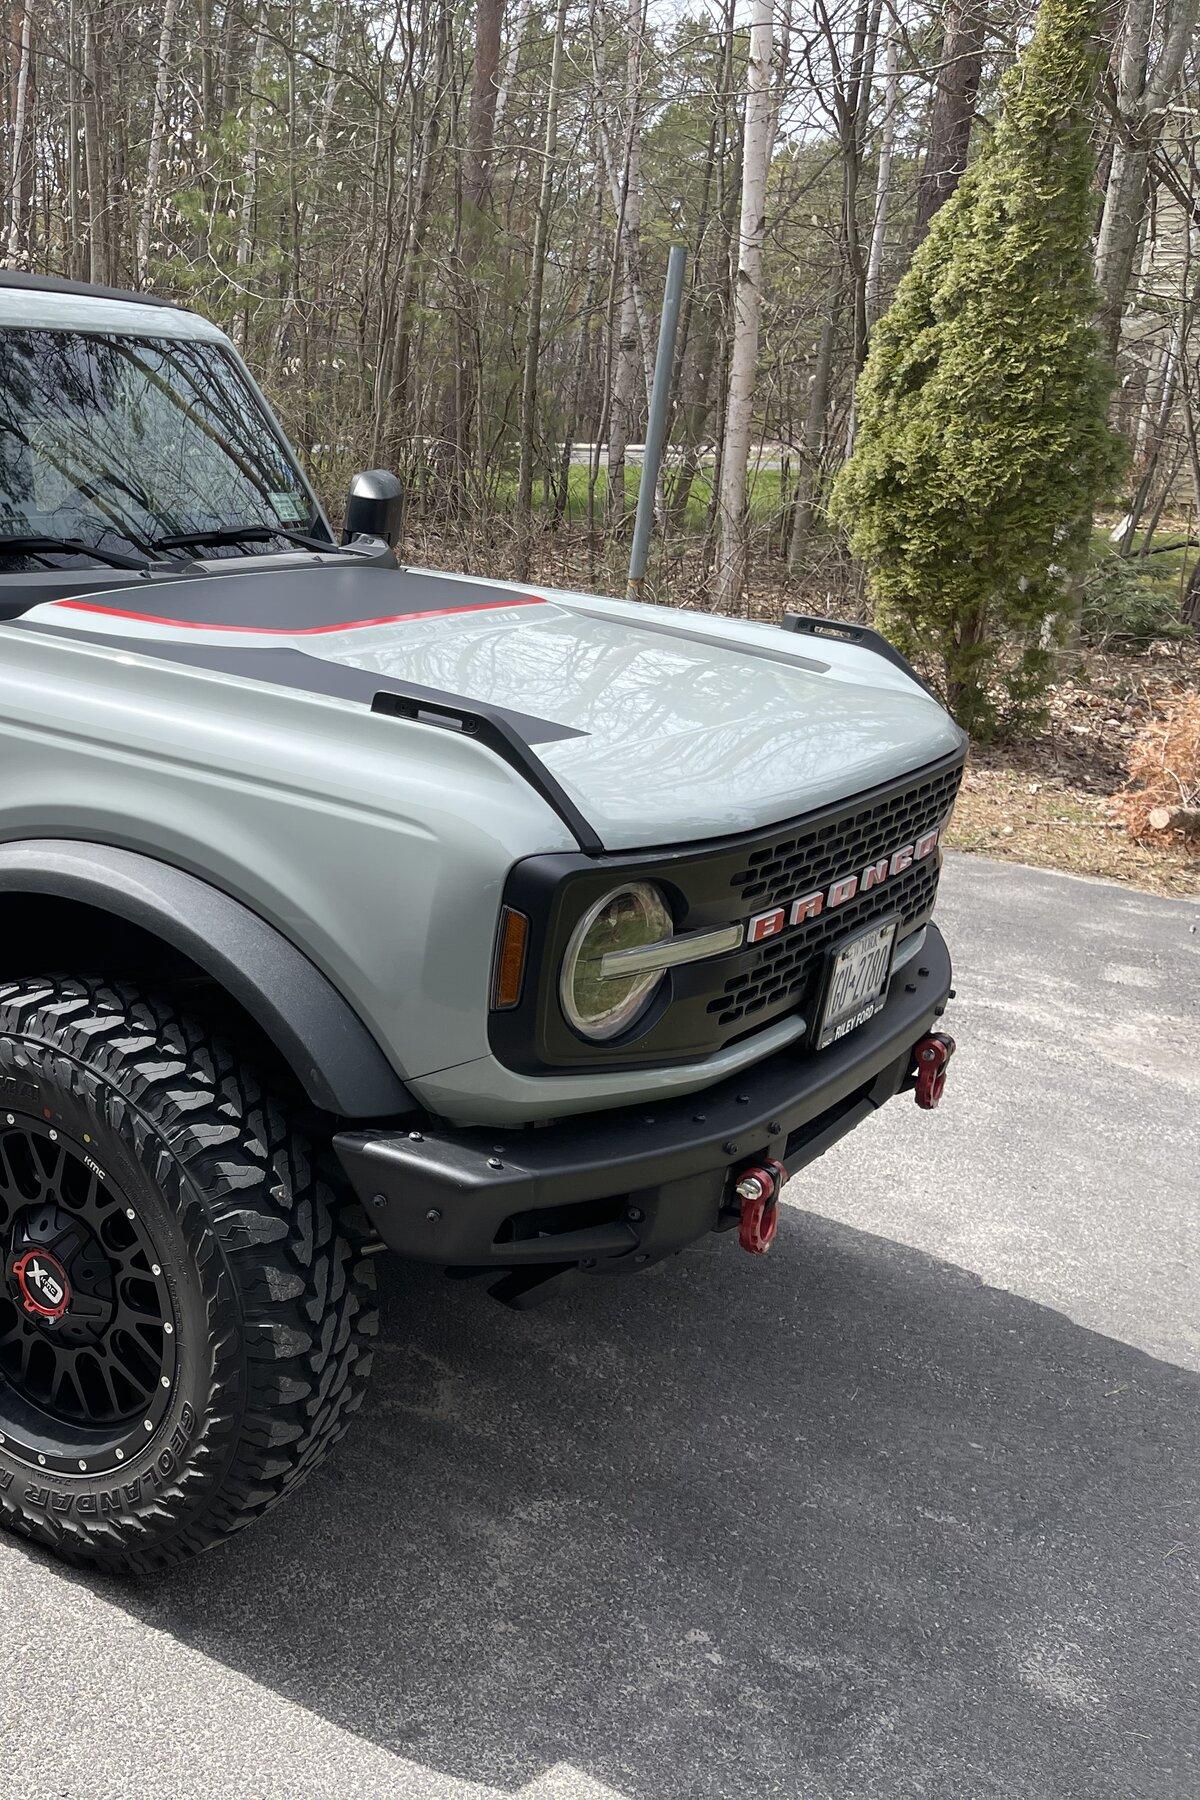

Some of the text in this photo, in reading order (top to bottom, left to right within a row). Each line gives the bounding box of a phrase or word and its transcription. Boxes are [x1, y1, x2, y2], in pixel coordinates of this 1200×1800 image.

[747, 828, 939, 942] BRONCO
[853, 945, 888, 997] 2780
[834, 1015, 857, 1041] RILEY
[856, 1004, 874, 1027] FORD
[26, 1258, 63, 1304] XD
[23, 1400, 195, 1514] GEOLANDAR
